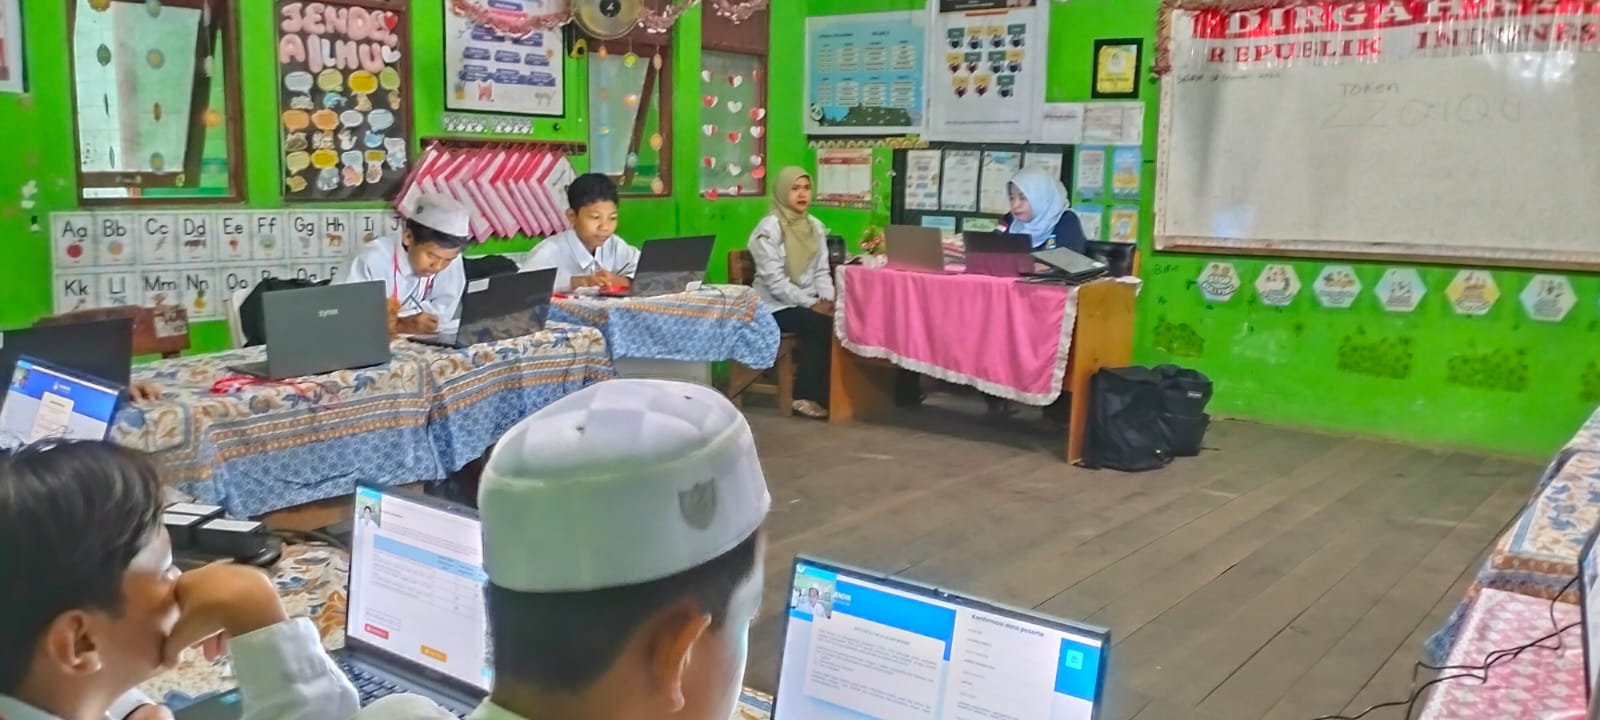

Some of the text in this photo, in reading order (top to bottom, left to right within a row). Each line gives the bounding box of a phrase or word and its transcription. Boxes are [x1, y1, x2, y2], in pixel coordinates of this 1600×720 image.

[1208, 37, 1381, 63] REPUBLIK
[62, 220, 88, 238] Aa
[103, 219, 127, 237] Bb
[145, 217, 169, 235] Cc
[183, 217, 206, 235] Dd
[223, 217, 244, 235] Ee
[257, 216, 277, 233] Ff
[294, 216, 315, 236] Gg
[326, 216, 344, 232] Hh
[64, 279, 89, 296] Kk
[109, 276, 126, 295] Ll
[144, 275, 177, 291] Mm
[186, 274, 209, 291] Nn
[226, 272, 248, 289] Oo
